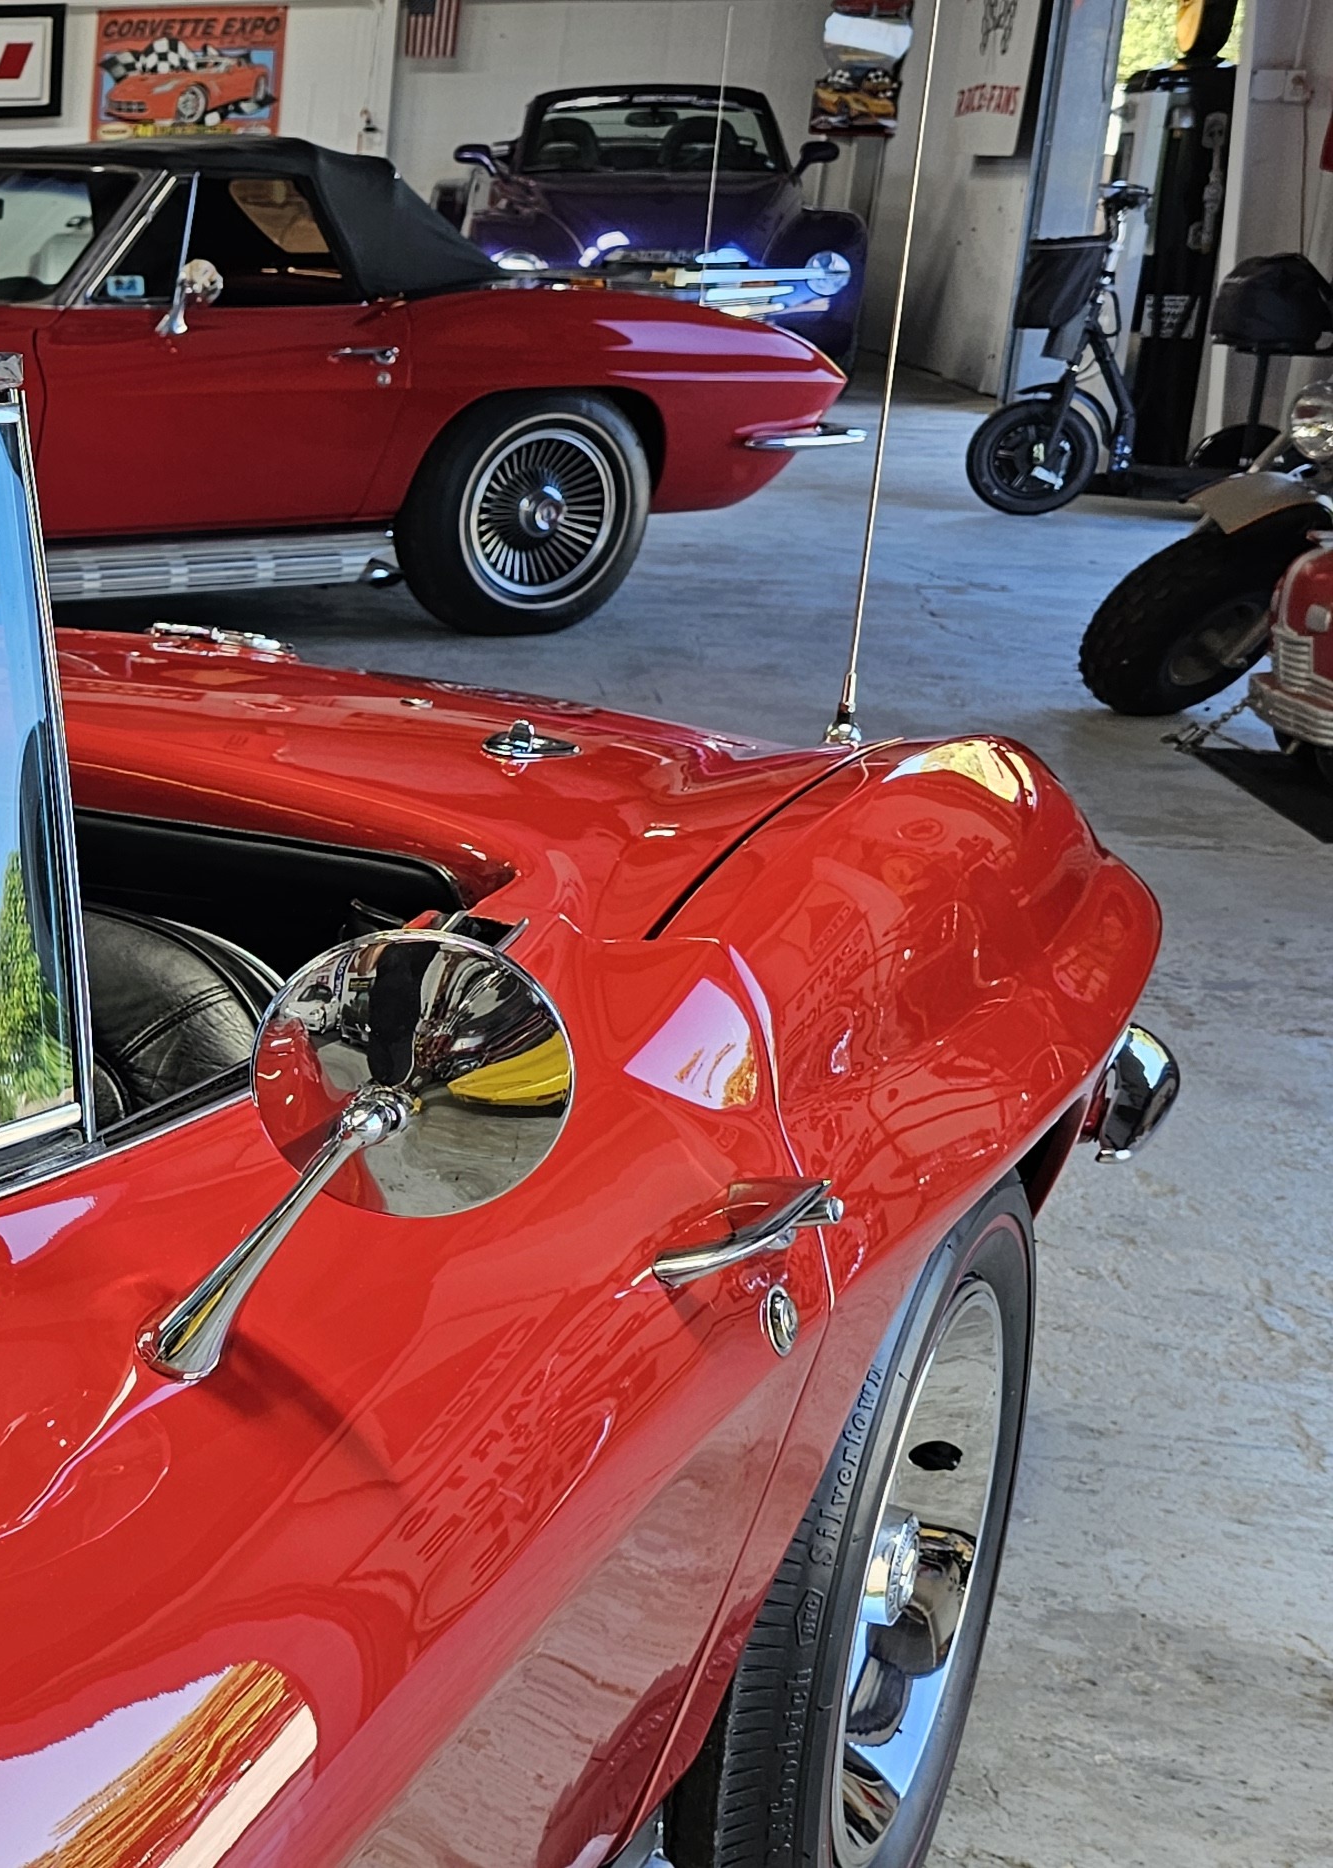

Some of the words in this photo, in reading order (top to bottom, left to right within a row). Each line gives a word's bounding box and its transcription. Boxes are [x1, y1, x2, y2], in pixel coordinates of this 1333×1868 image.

[102, 18, 219, 38] CORVETTE
[221, 16, 282, 37] EXPO
[807, 1364, 884, 1567] Silvertown
[800, 1598, 821, 1636] BFG
